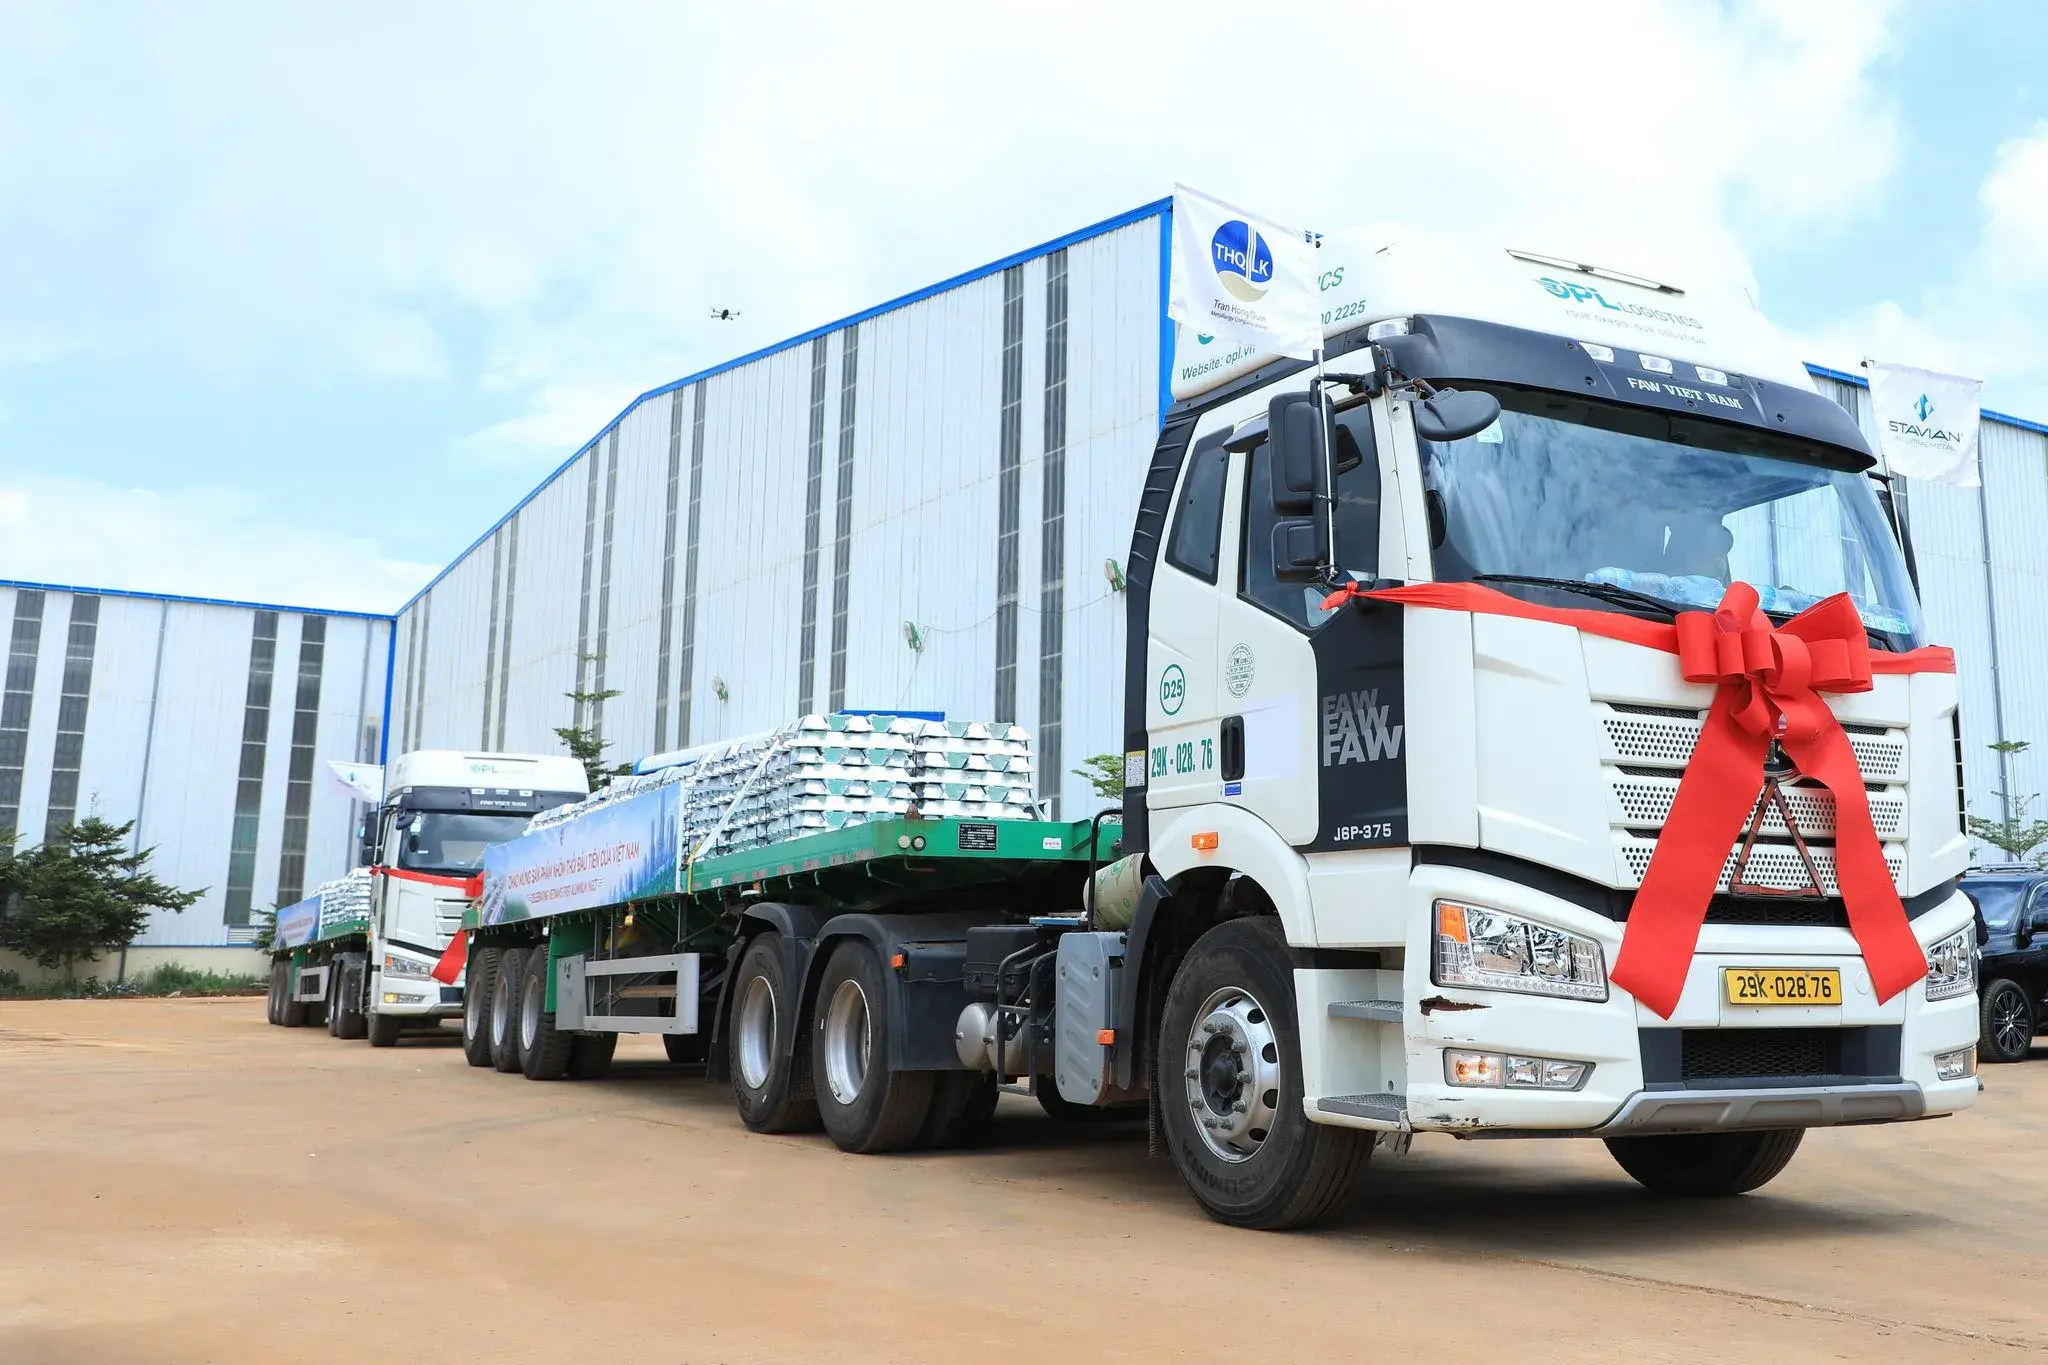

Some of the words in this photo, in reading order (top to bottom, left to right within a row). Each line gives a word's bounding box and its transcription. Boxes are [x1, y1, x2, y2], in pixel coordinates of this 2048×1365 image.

[1213, 298, 1230, 311] Tran
[1334, 299, 1366, 321] 2225
[1534, 276, 1621, 312] OPL
[1617, 300, 1703, 330] LOGISTICS
[1182, 357, 1224, 380] Website:
[1626, 376, 1661, 393] FAW
[1662, 383, 1703, 401] VIET
[1706, 392, 1744, 410] NAM
[1889, 420, 1961, 443] STAVIAN
[1163, 679, 1182, 700] D25
[1322, 688, 1379, 715] FAW
[1323, 704, 1390, 736] FAW
[1323, 725, 1403, 767] FAW
[1151, 745, 1168, 778] 29K
[1176, 741, 1196, 774] 028.
[1201, 738, 1213, 770] 76
[1333, 822, 1392, 842] J6P-375
[1738, 976, 1832, 998] 29K-028.76
